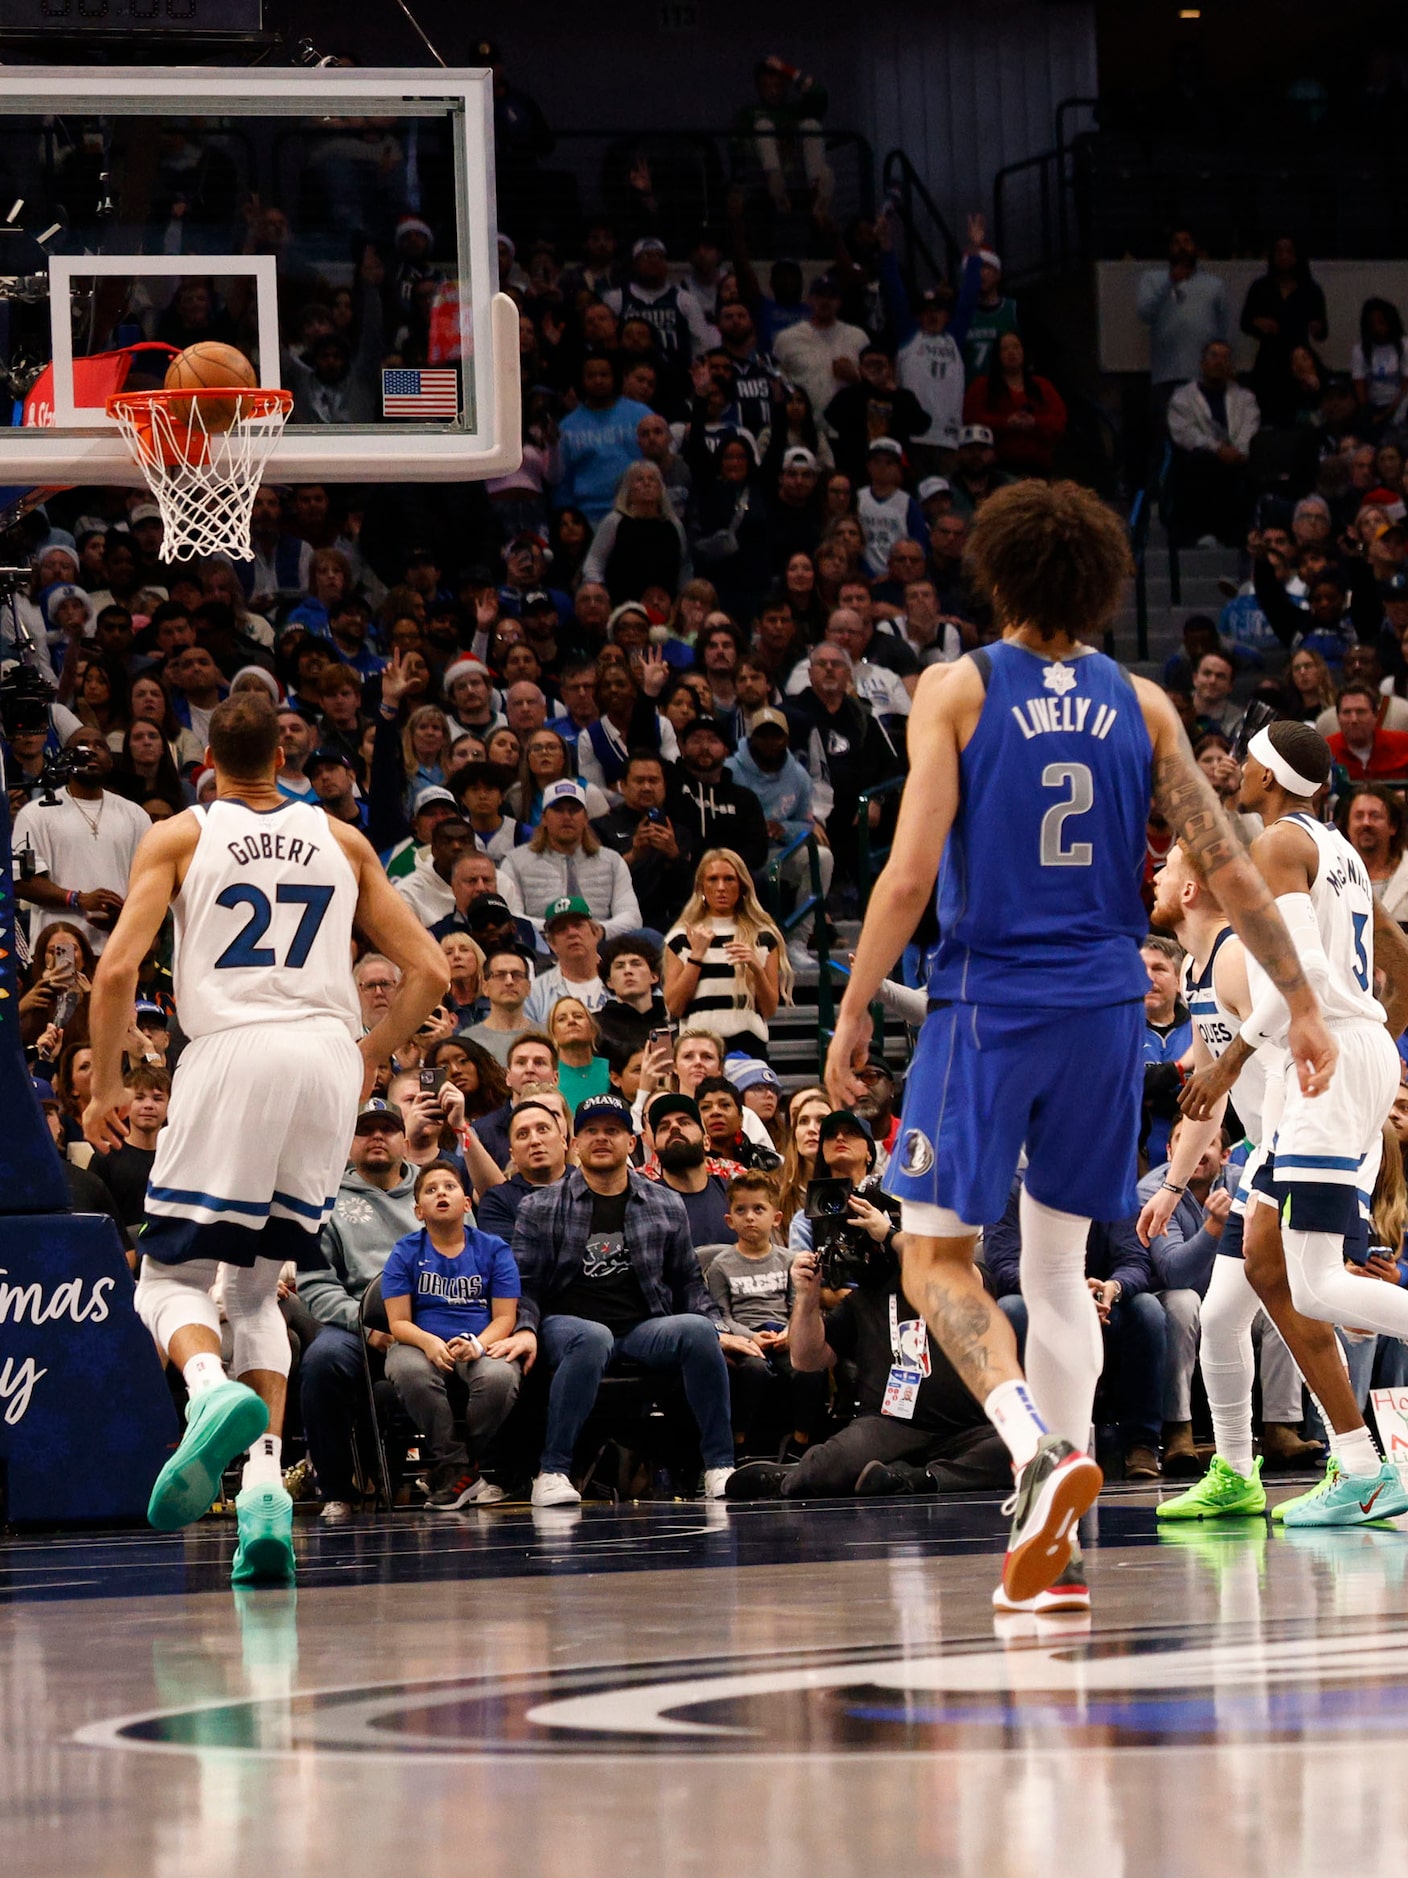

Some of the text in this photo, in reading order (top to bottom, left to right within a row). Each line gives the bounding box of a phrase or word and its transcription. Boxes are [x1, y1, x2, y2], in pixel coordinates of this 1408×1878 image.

[1011, 697, 1092, 740] LIVELY
[1040, 762, 1094, 876] 2
[227, 833, 320, 866] GOBERT
[214, 882, 336, 969] 27
[1351, 911, 1369, 993] 3
[583, 1095, 623, 1111] MAVS
[0, 1268, 116, 1326] mas
[418, 1271, 483, 1301] DALLAS
